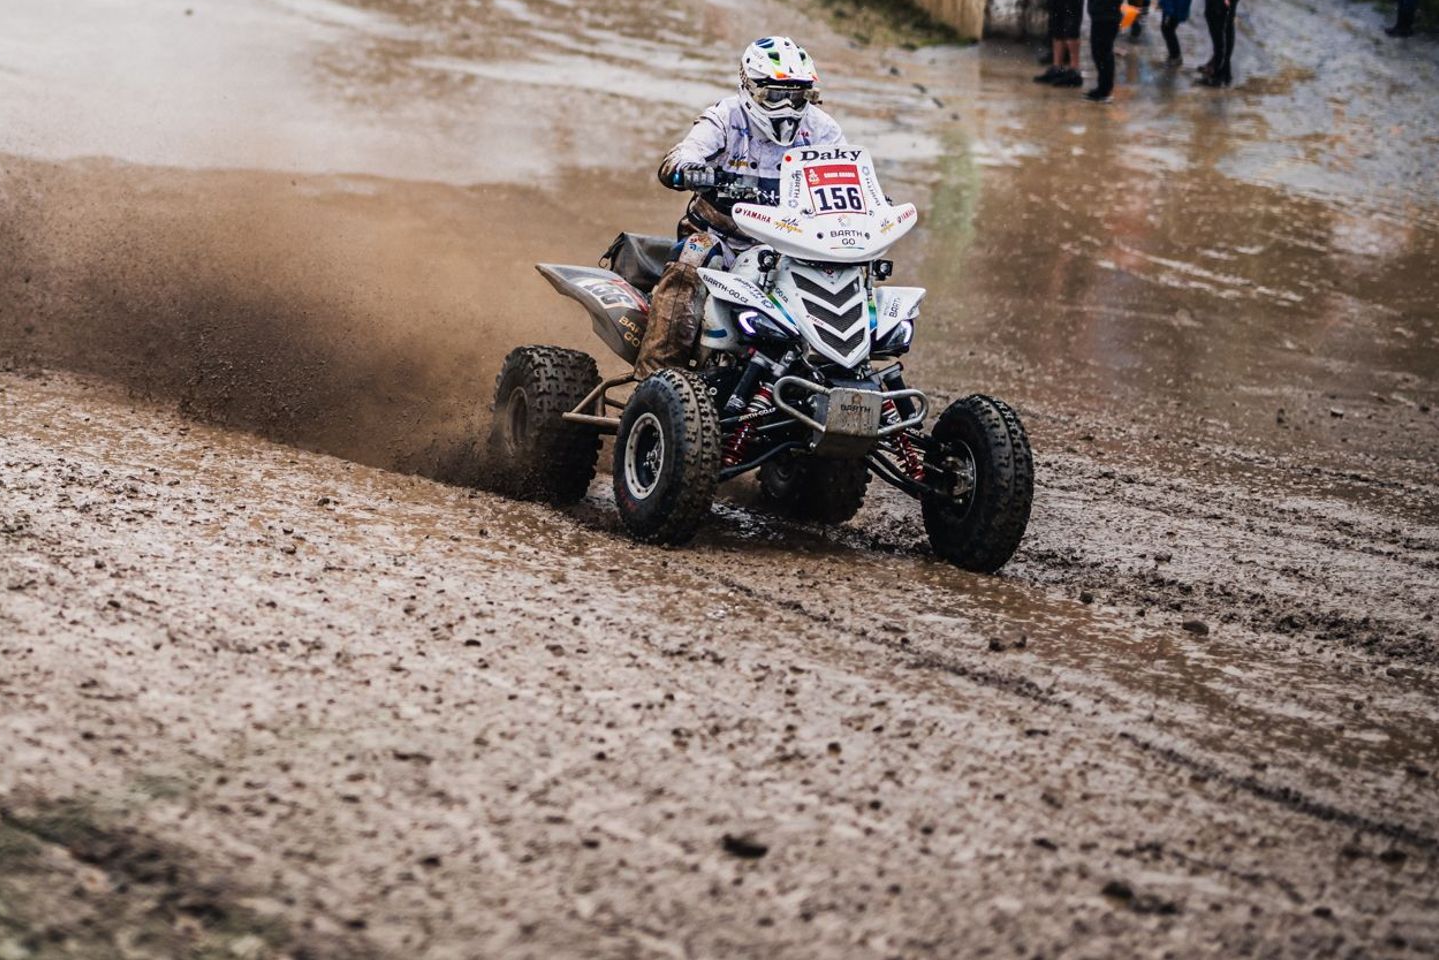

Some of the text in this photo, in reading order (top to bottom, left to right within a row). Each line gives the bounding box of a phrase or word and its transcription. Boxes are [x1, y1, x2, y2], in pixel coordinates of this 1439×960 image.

[800, 148, 863, 161] Daky
[814, 187, 863, 211] 156
[743, 209, 771, 223] YAMAHA
[830, 229, 863, 238] BARTH
[841, 238, 856, 246] GO
[623, 331, 641, 348] GO
